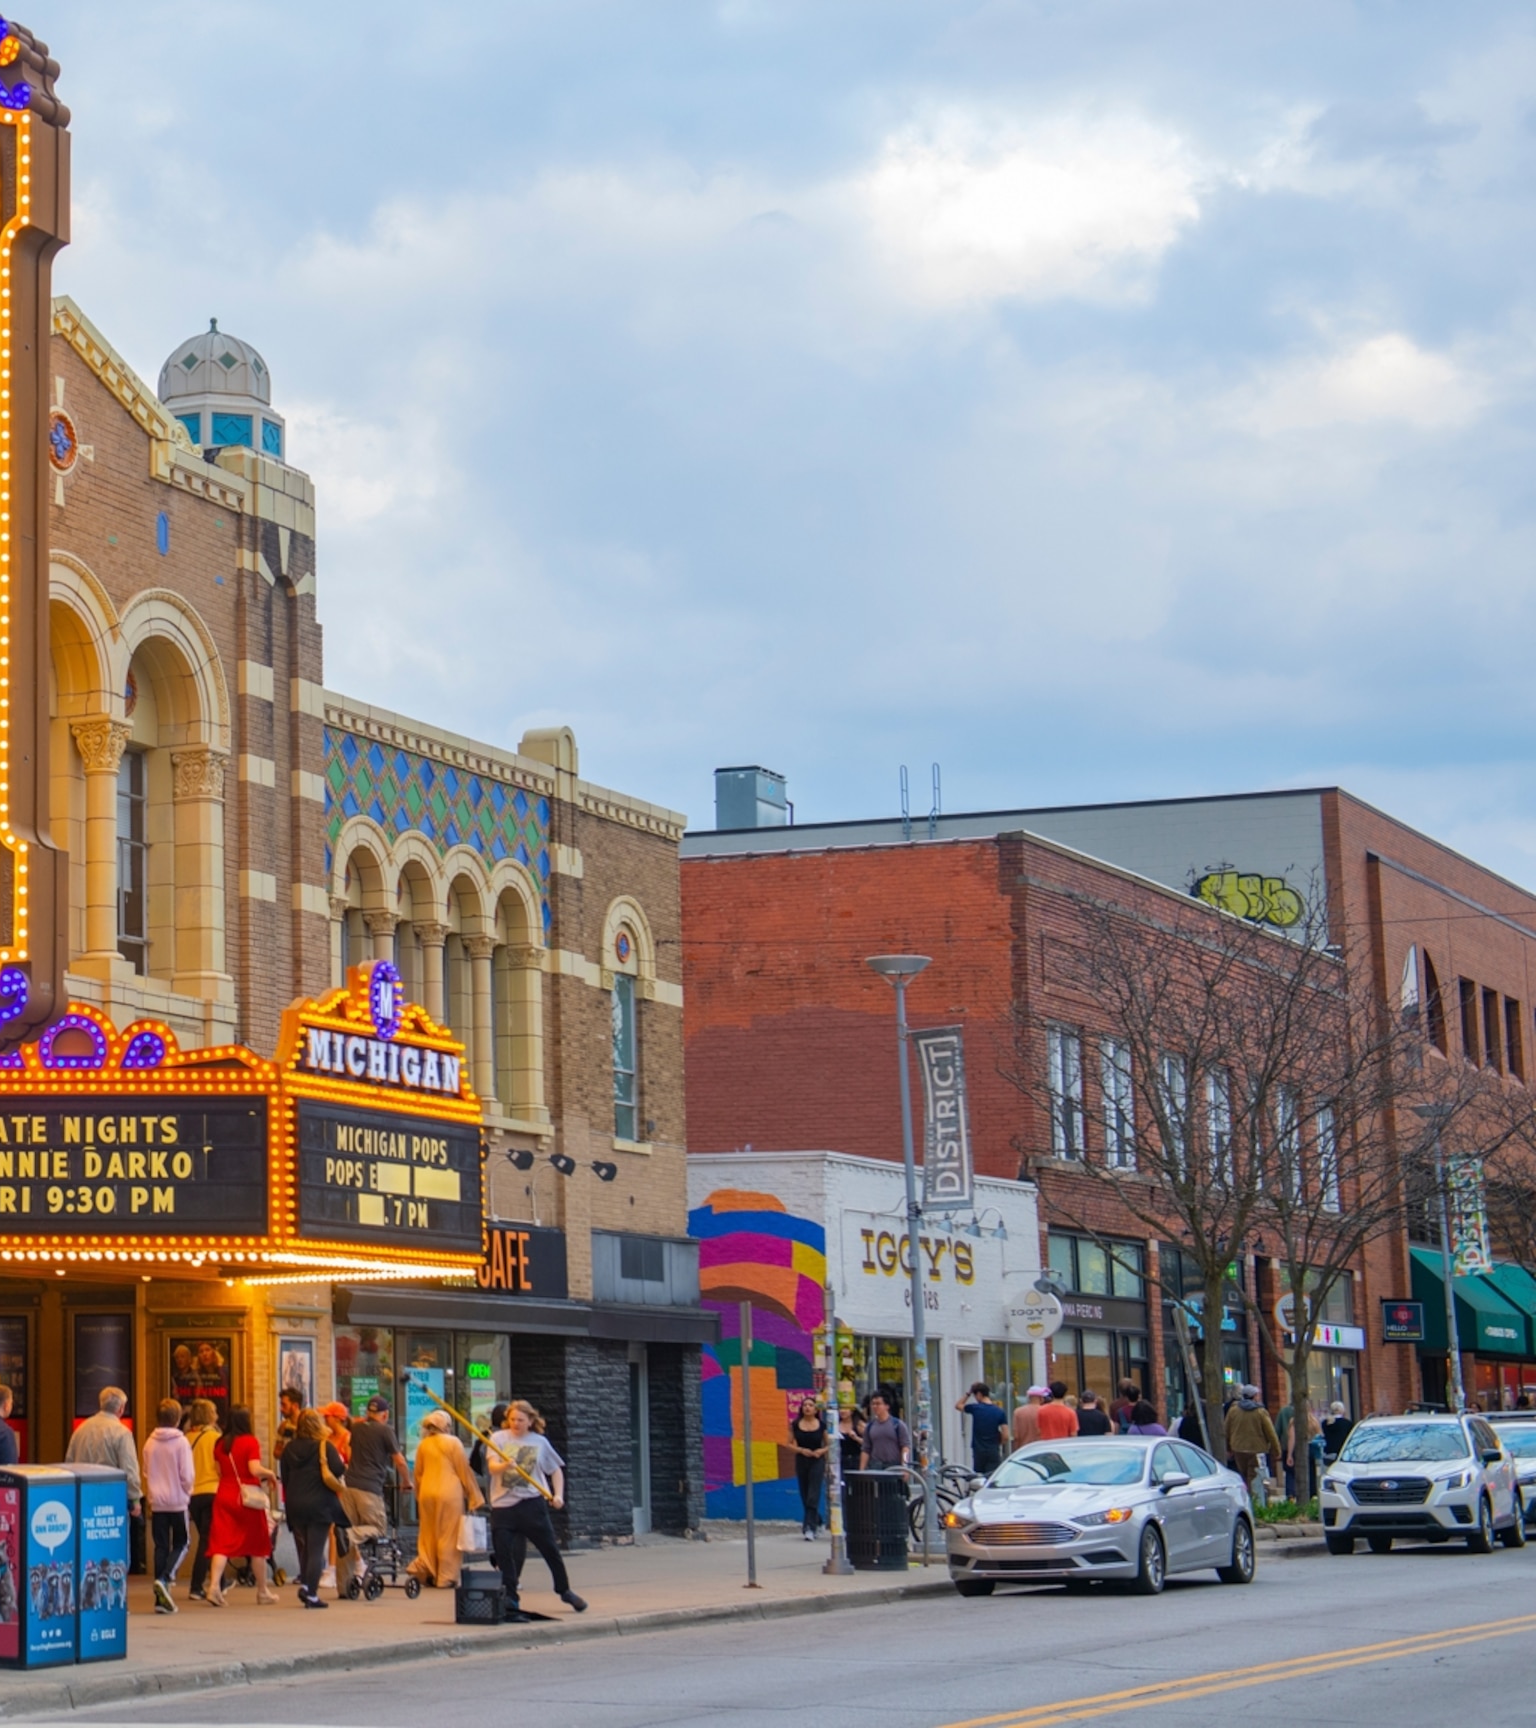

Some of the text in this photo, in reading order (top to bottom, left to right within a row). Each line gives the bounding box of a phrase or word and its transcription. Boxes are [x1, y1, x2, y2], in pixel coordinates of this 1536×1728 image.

[379, 981, 393, 1019] M
[306, 1026, 461, 1094] MICHIGAN
[64, 1117, 178, 1143] NIGHTS
[928, 1045, 961, 1192] DISTRICT
[336, 1124, 448, 1166] MICHIGAN POPS
[85, 1151, 193, 1178] DARKO
[326, 1157, 364, 1189] POPS
[47, 1186, 116, 1213] 9:30
[131, 1186, 176, 1213] PM
[394, 1200, 429, 1228] 7 PM
[478, 1229, 532, 1290] CAFE
[861, 1228, 975, 1286] IGGY'S
[904, 1284, 939, 1311] eies
[1011, 1308, 1058, 1317] IGGY'S
[468, 1362, 491, 1379] OPEN
[83, 1516, 124, 1528] THE RULES OF
[94, 1506, 114, 1516] LEARN
